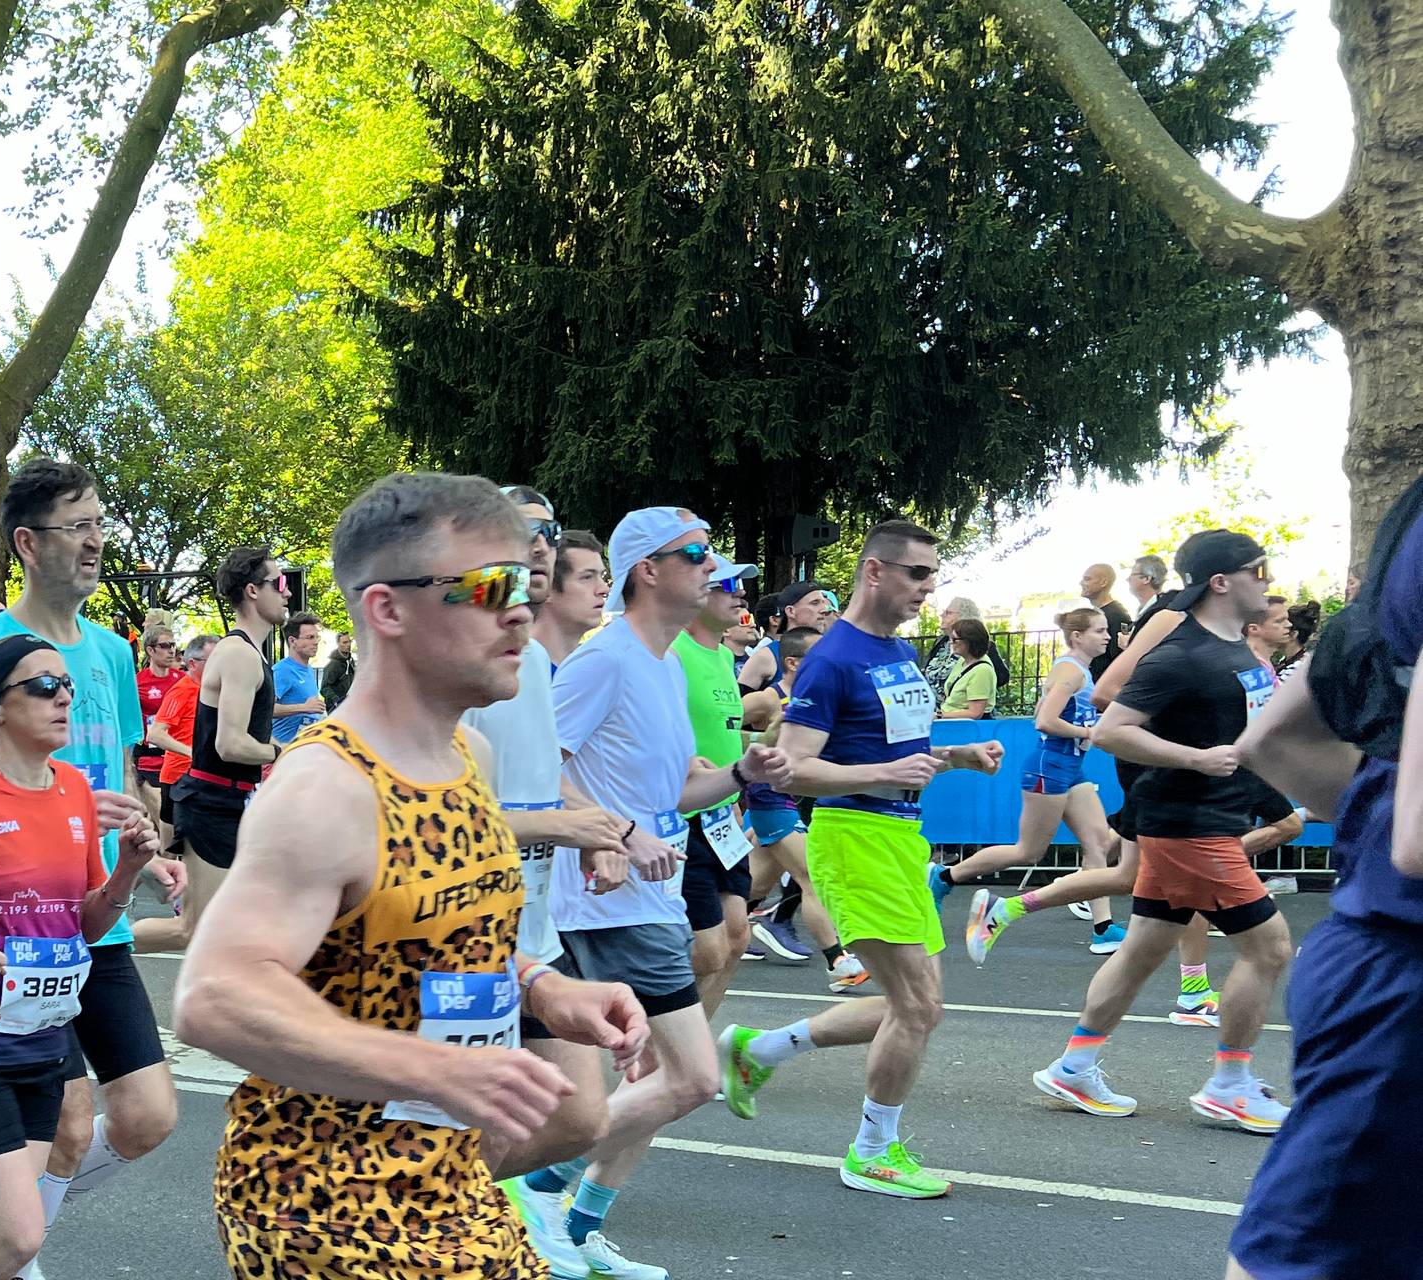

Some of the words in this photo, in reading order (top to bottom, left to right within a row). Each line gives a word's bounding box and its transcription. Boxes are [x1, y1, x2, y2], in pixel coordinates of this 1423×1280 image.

[892, 688, 930, 707] 4779
[34, 903, 66, 914] 42.195
[11, 939, 33, 952] uni
[52, 942, 71, 953] uni
[15, 951, 41, 964] per
[53, 951, 74, 965] per
[23, 973, 81, 998] 3891
[431, 975, 465, 995] uni
[438, 994, 477, 1014] per
